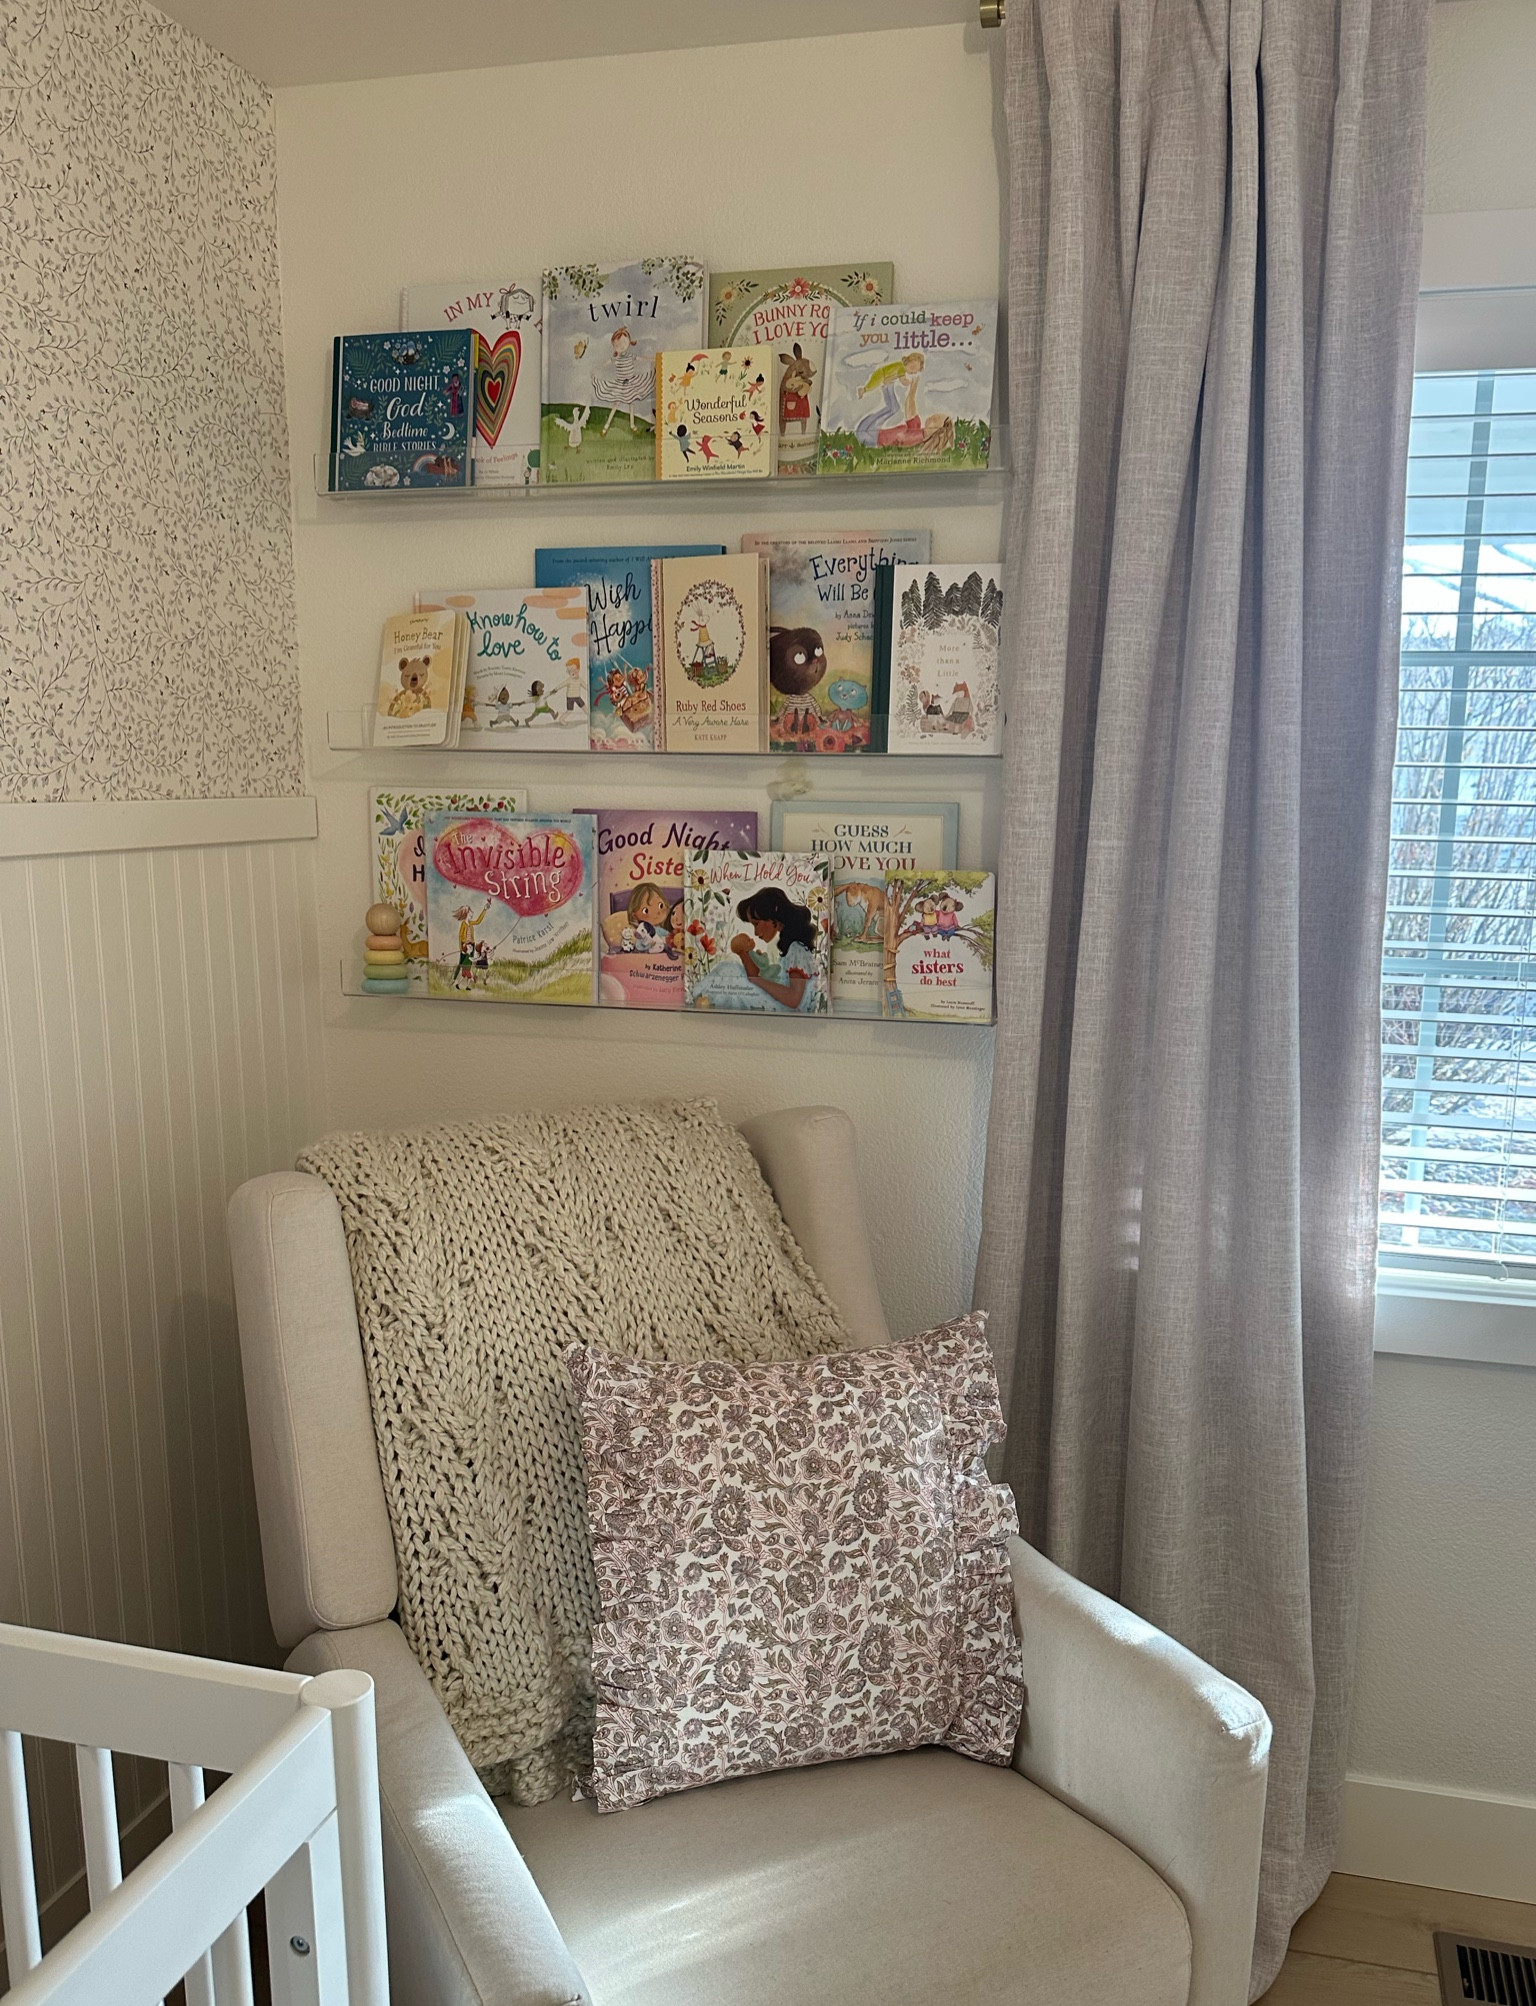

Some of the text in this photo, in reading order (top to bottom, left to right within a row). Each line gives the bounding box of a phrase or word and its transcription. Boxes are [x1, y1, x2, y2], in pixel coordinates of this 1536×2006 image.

[443, 292, 494, 322] IN MY
[588, 294, 659, 322] twirl
[753, 303, 831, 327] BUNNY RO
[852, 311, 974, 332] If i could keep
[752, 321, 829, 344] I LOVE YO
[859, 329, 973, 350] you little...
[370, 377, 400, 393] GOOD
[386, 392, 426, 421] God
[684, 395, 747, 413] Wonderful
[692, 411, 739, 425] Seasons
[381, 421, 429, 440] Bedtime
[373, 441, 437, 452] BIBLE STORIES
[913, 455, 951, 464] Richmond
[809, 547, 919, 583] Everythi
[585, 572, 642, 613] Wish
[817, 582, 845, 602] Will
[850, 583, 869, 601] Be
[843, 609, 861, 618] Anna
[394, 627, 444, 644] Honey Bear
[515, 603, 548, 645] how
[546, 636, 562, 661] to
[836, 631, 852, 643] Judy
[477, 630, 525, 658] love
[939, 644, 960, 652] More
[676, 699, 747, 715] Ruby Red Shoes
[672, 715, 749, 731] A Very Aware Hare
[452, 832, 474, 846] The
[598, 822, 655, 855] Good
[834, 824, 889, 838] GUESS
[444, 834, 566, 874] Invisible
[811, 839, 913, 854] HOW MUCH
[629, 852, 684, 881] Siste
[833, 856, 917, 871] OVE YOU
[710, 861, 811, 886] When I Hold You
[484, 870, 562, 903] String
[512, 934, 536, 944] Patrice
[923, 948, 951, 959] what
[652, 963, 682, 972] Katherine
[911, 959, 964, 974] sisters
[629, 970, 679, 983] Schwarzenegger
[920, 975, 957, 987] do best
